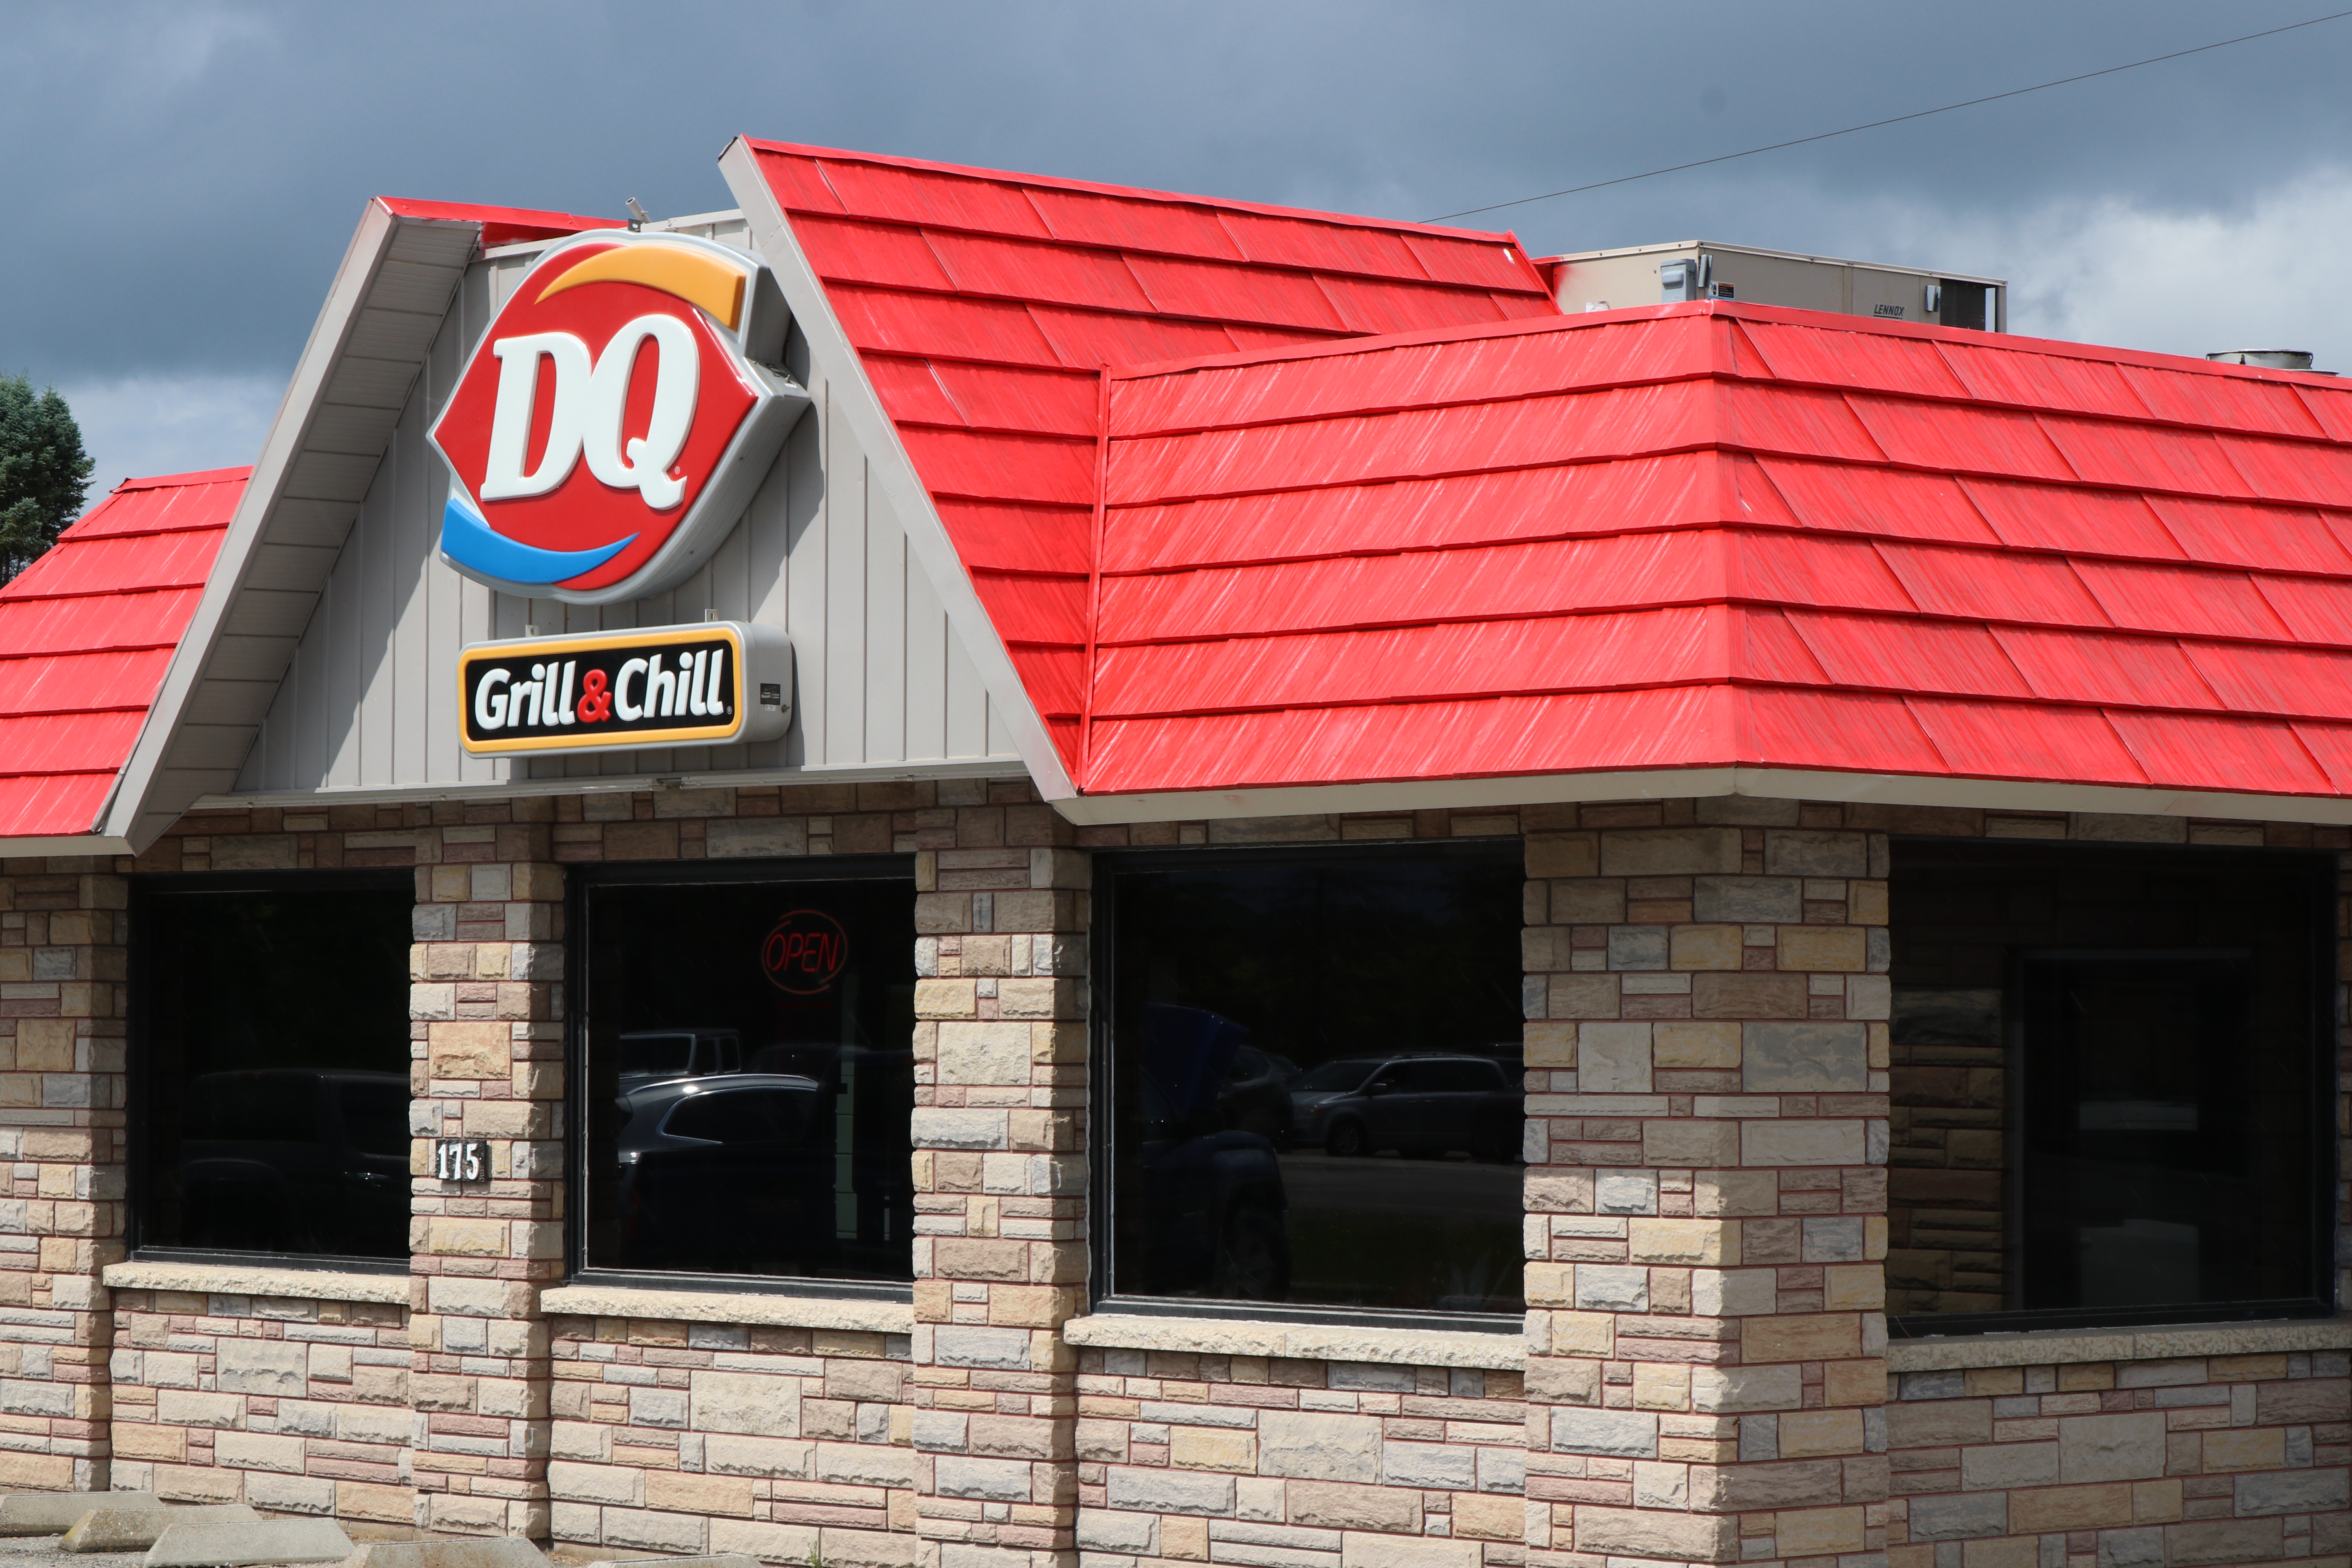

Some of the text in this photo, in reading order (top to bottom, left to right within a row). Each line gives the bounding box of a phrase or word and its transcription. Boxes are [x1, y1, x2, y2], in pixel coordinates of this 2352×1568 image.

[1874, 303, 1905, 316] LENNOX
[480, 314, 700, 510] DQ
[766, 933, 840, 972] OPEN
[437, 1143, 479, 1180] 175
